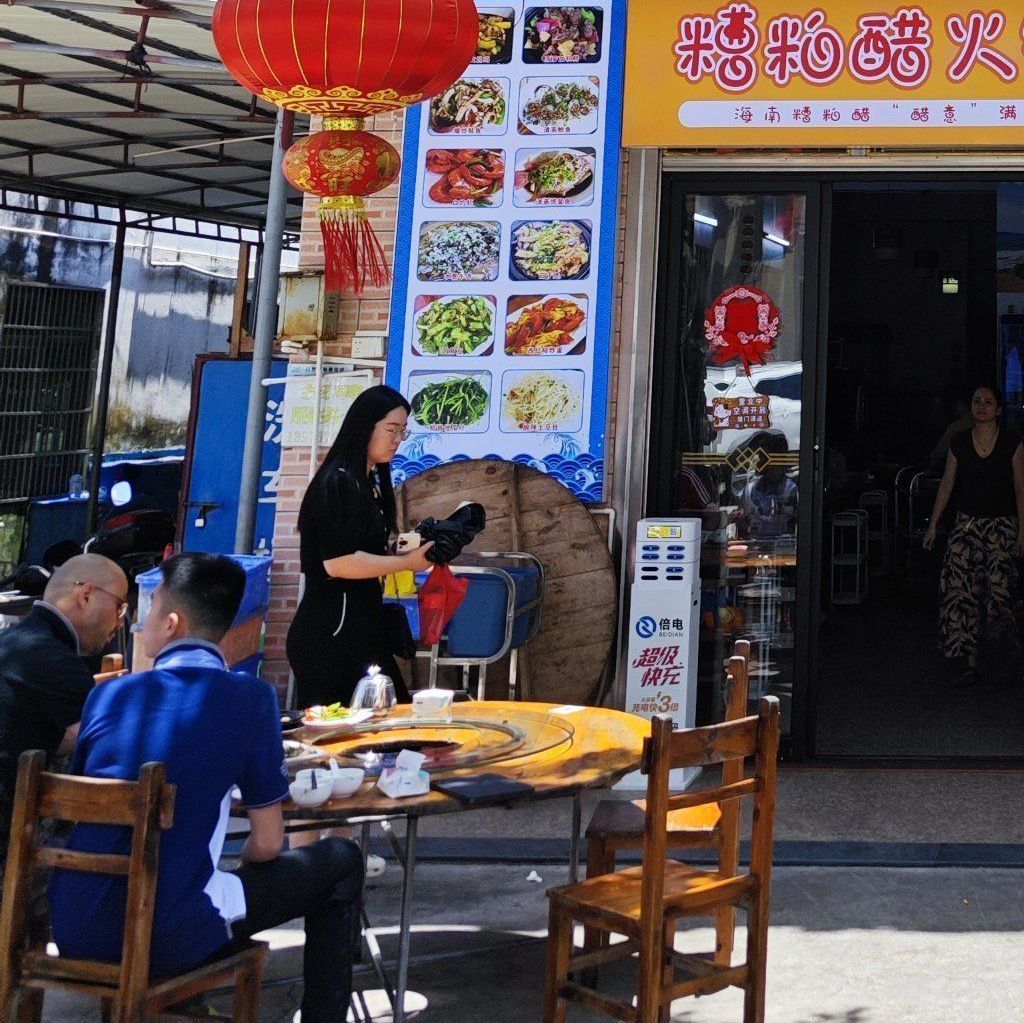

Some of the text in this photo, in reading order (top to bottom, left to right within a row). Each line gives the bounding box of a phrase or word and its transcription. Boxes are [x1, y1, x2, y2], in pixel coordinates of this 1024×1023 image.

[658, 618, 684, 631] 倍电
[632, 645, 681, 668] 超级
[640, 665, 685, 688] 快充
